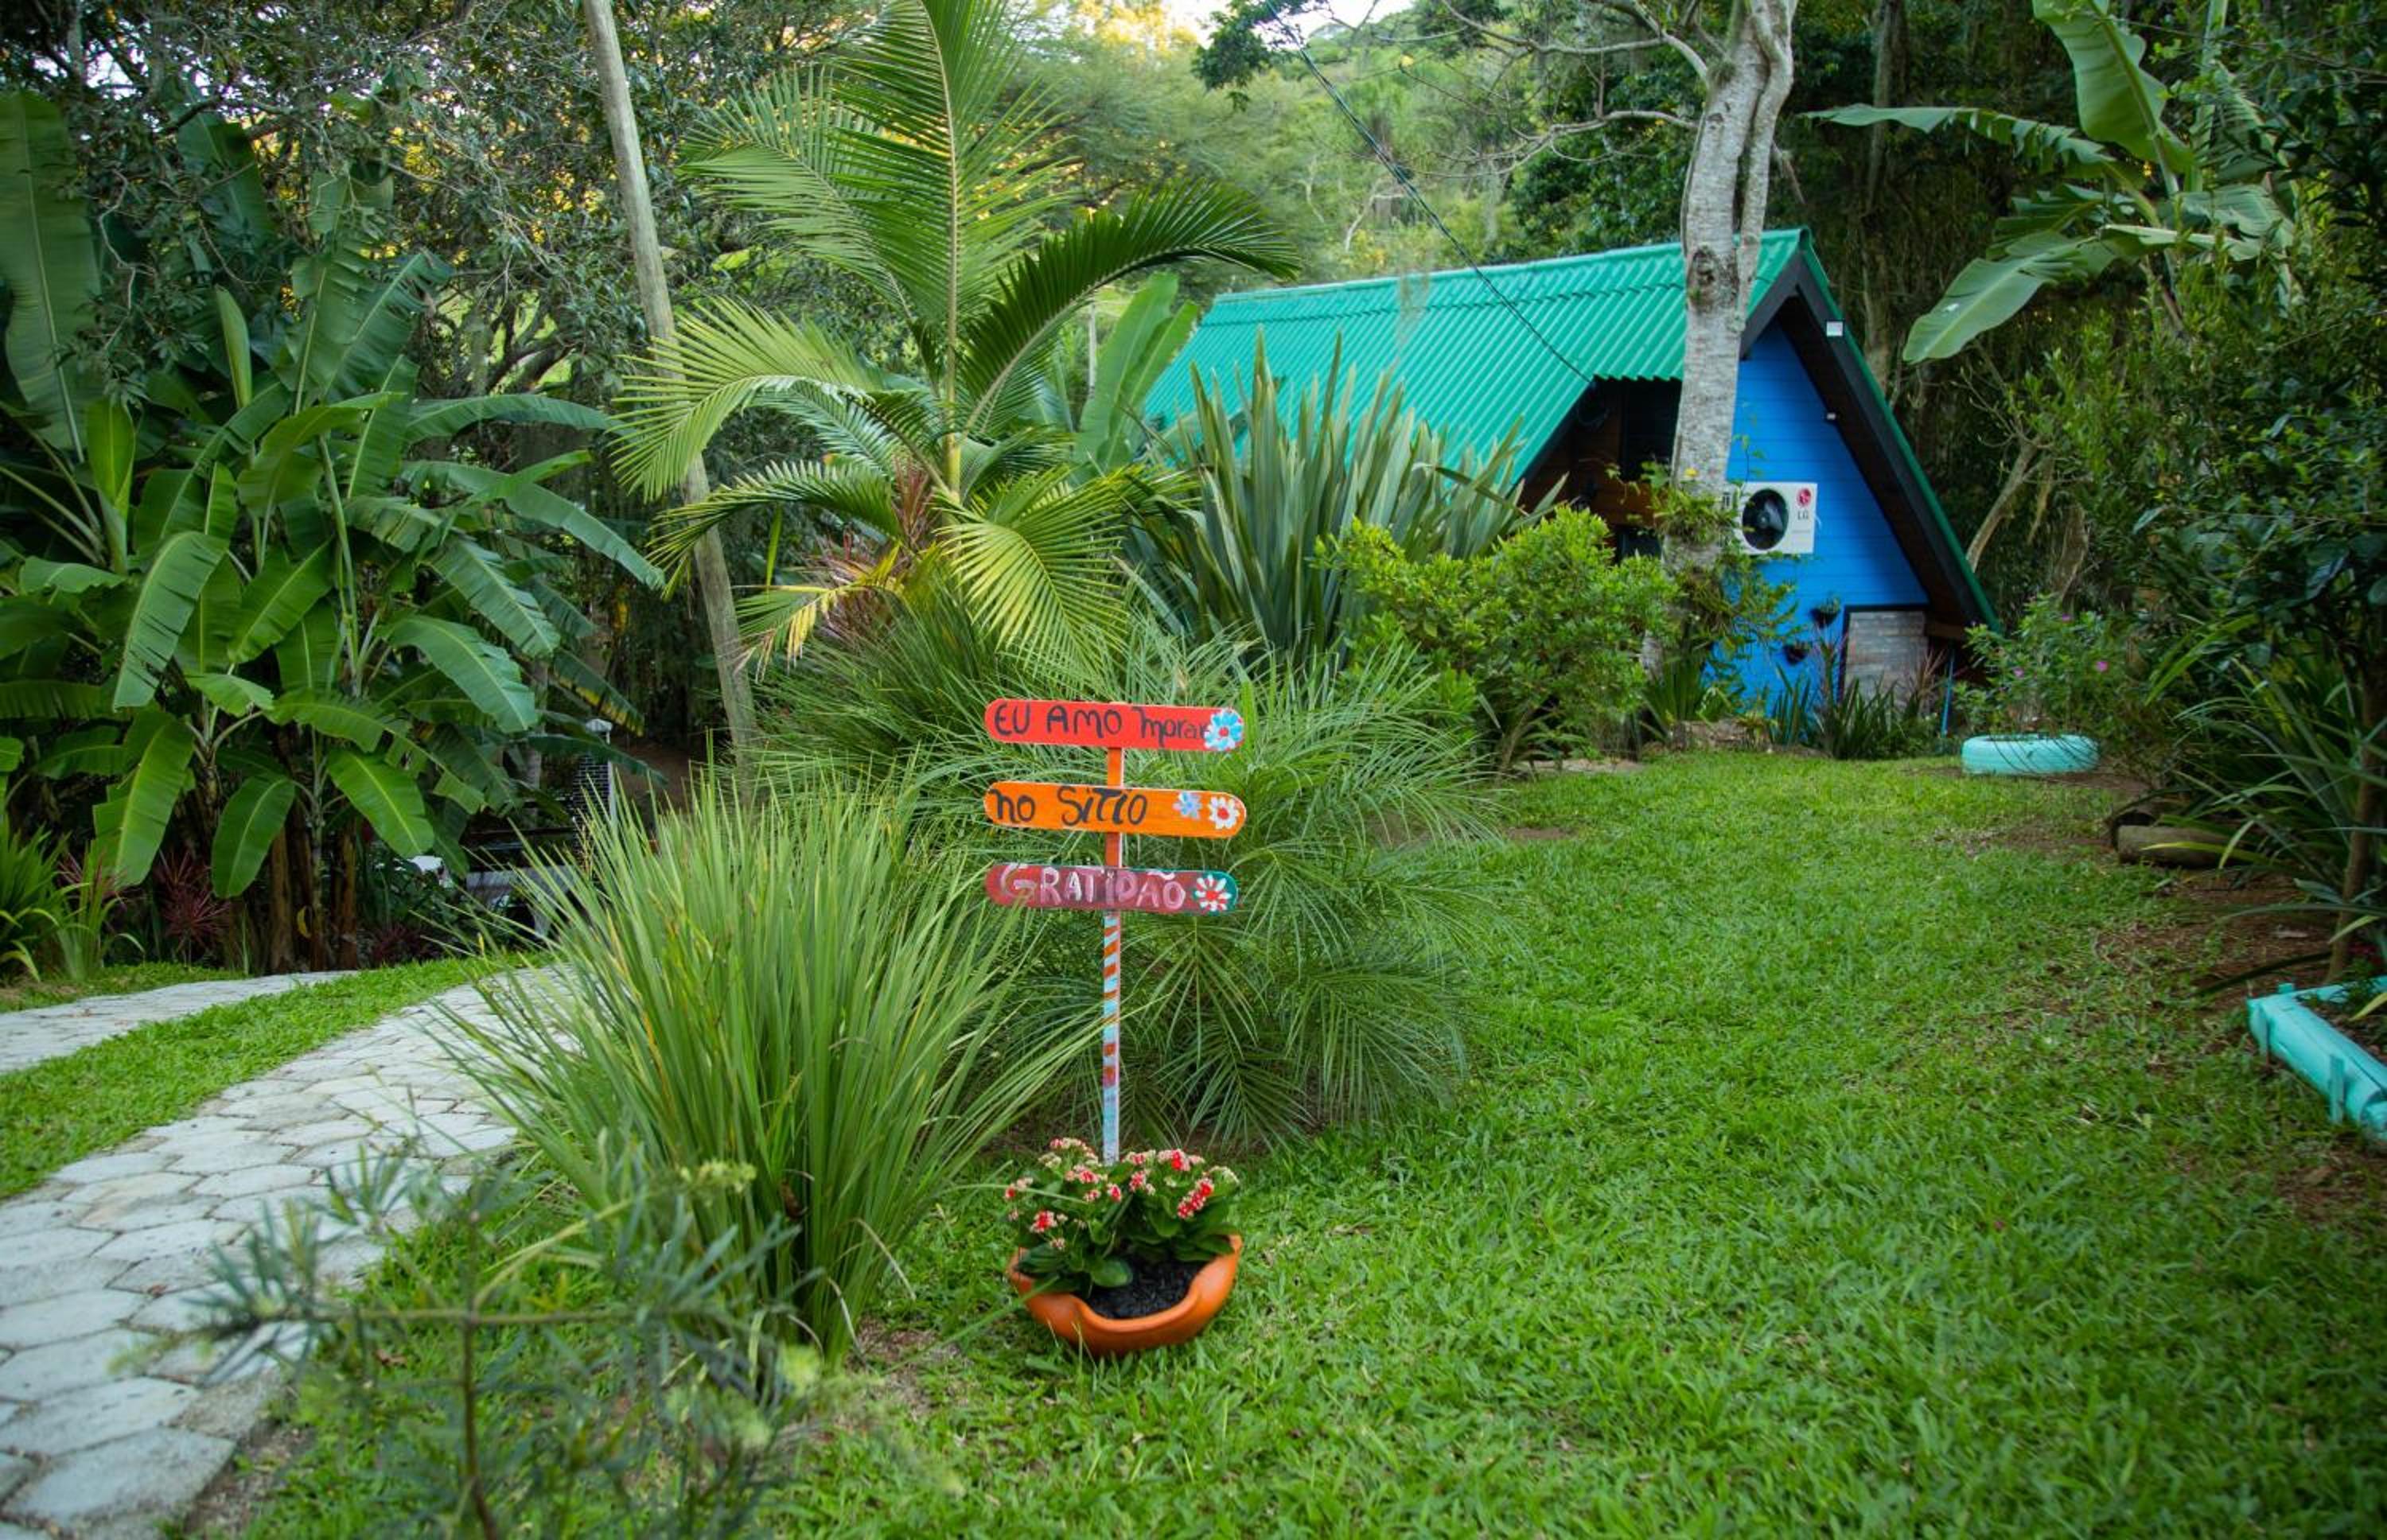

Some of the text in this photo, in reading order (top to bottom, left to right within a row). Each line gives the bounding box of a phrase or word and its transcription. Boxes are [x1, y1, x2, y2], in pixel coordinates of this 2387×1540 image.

[1797, 510, 1809, 520] LG
[994, 703, 1031, 736] EU
[1046, 706, 1123, 739] AMO
